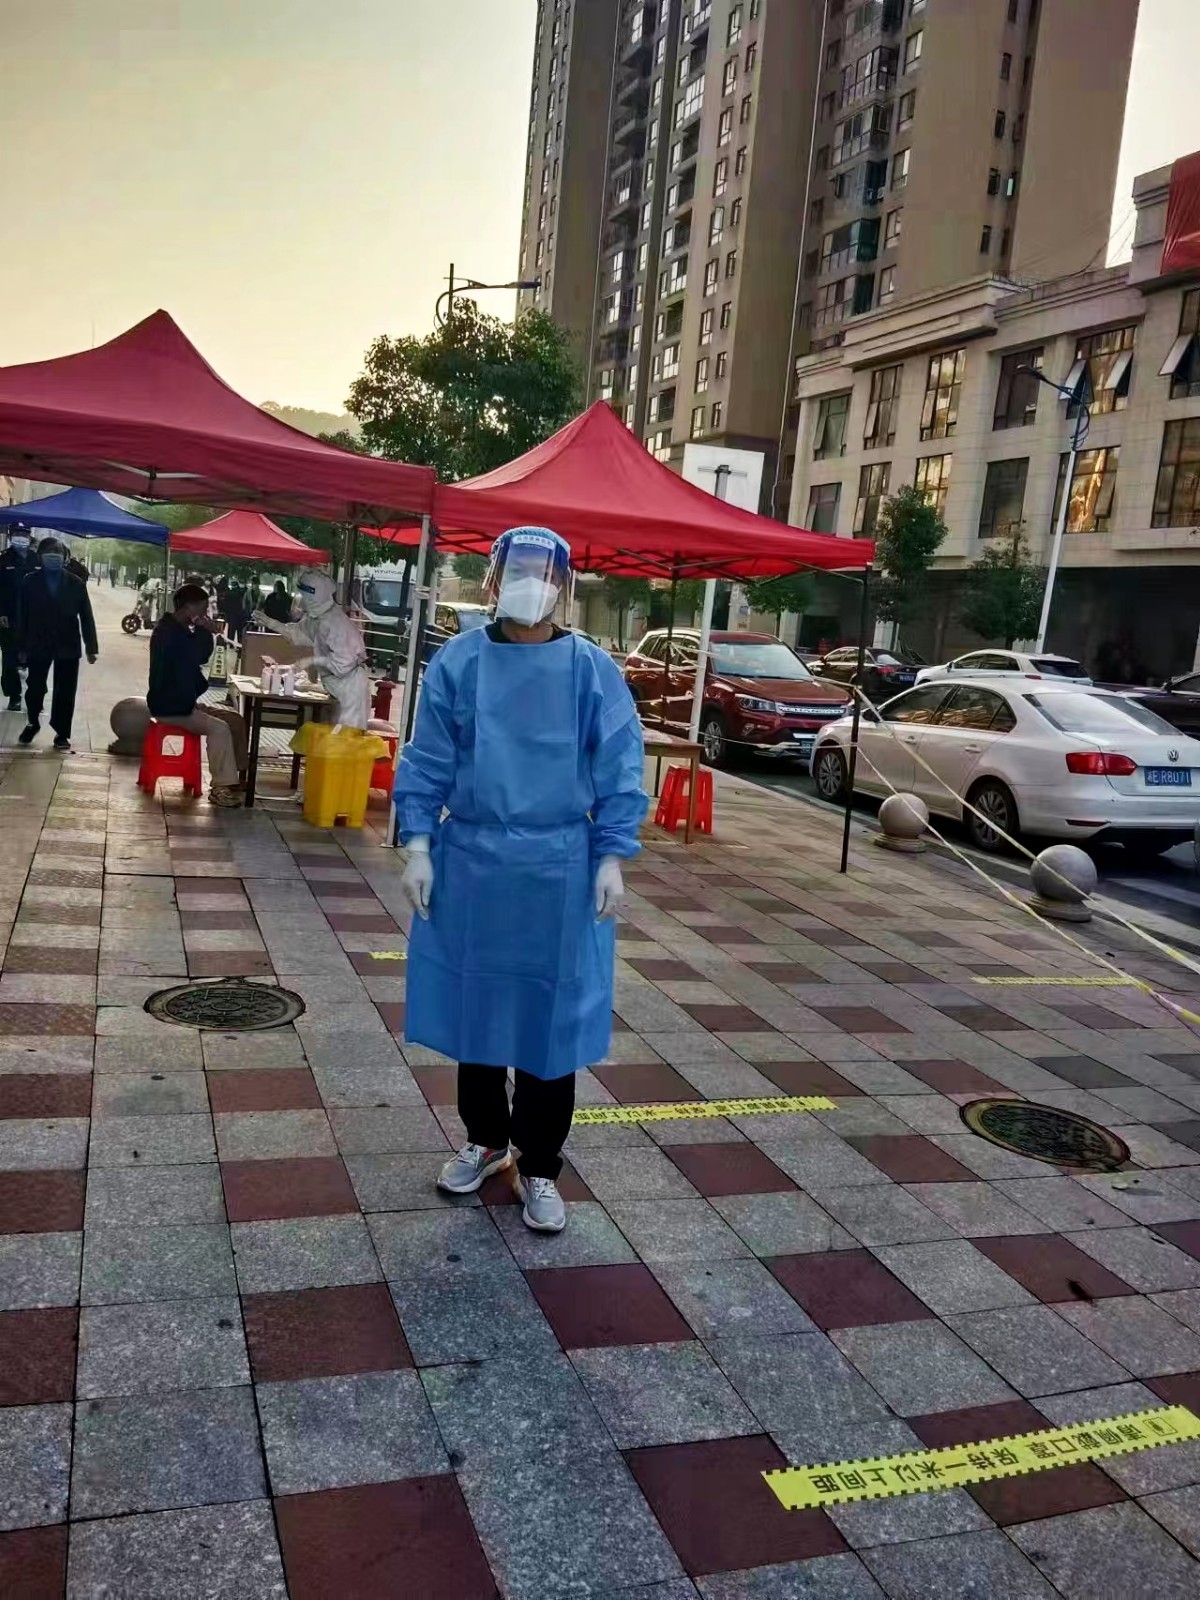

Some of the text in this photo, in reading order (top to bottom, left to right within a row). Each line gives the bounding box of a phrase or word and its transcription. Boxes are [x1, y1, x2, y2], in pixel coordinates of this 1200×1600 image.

[1026, 1423, 1146, 1459] 请佩戴口罩
[808, 1446, 1020, 1493] 保持一米以上间距
